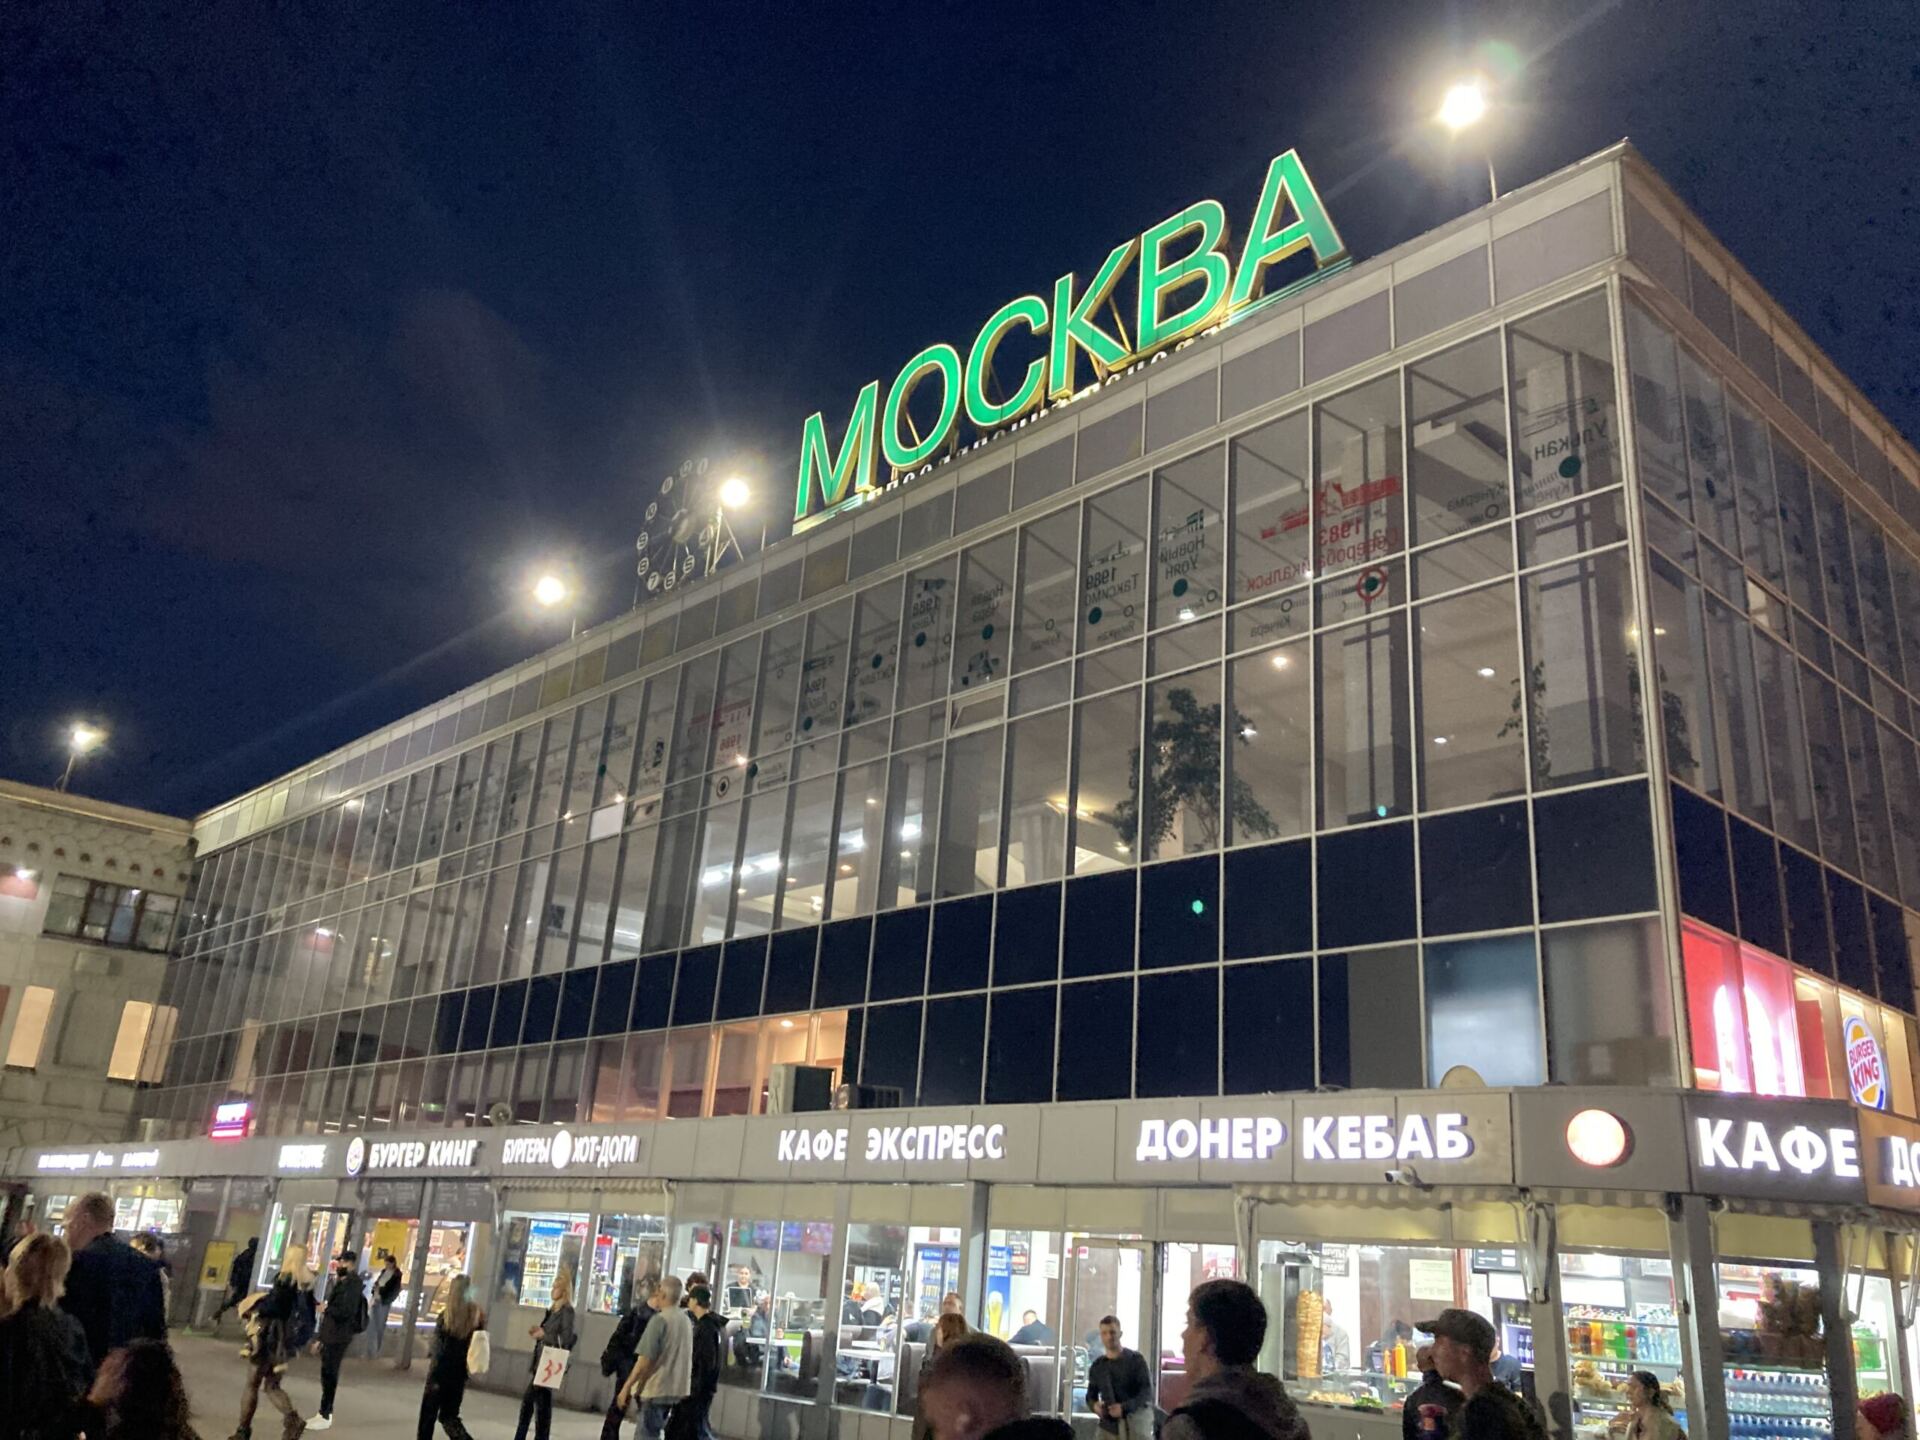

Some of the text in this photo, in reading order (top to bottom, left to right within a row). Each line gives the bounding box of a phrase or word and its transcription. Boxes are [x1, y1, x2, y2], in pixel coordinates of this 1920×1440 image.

[793, 147, 1345, 520] МОСКВА
[1849, 1039, 1876, 1068] BURGER
[1853, 1056, 1880, 1093] KING
[368, 1141, 425, 1168] БУРГЕР
[427, 1139, 478, 1167] КИНГ
[502, 1135, 638, 1167] БУРГЕРЫ ХОТ-ДОГИ
[778, 1123, 1005, 1161] КАФЕ ЭКСПРЕСС
[1136, 1112, 1471, 1161] ДОНЕР КЕБАБ
[1697, 1117, 1860, 1178] КАФЕ
